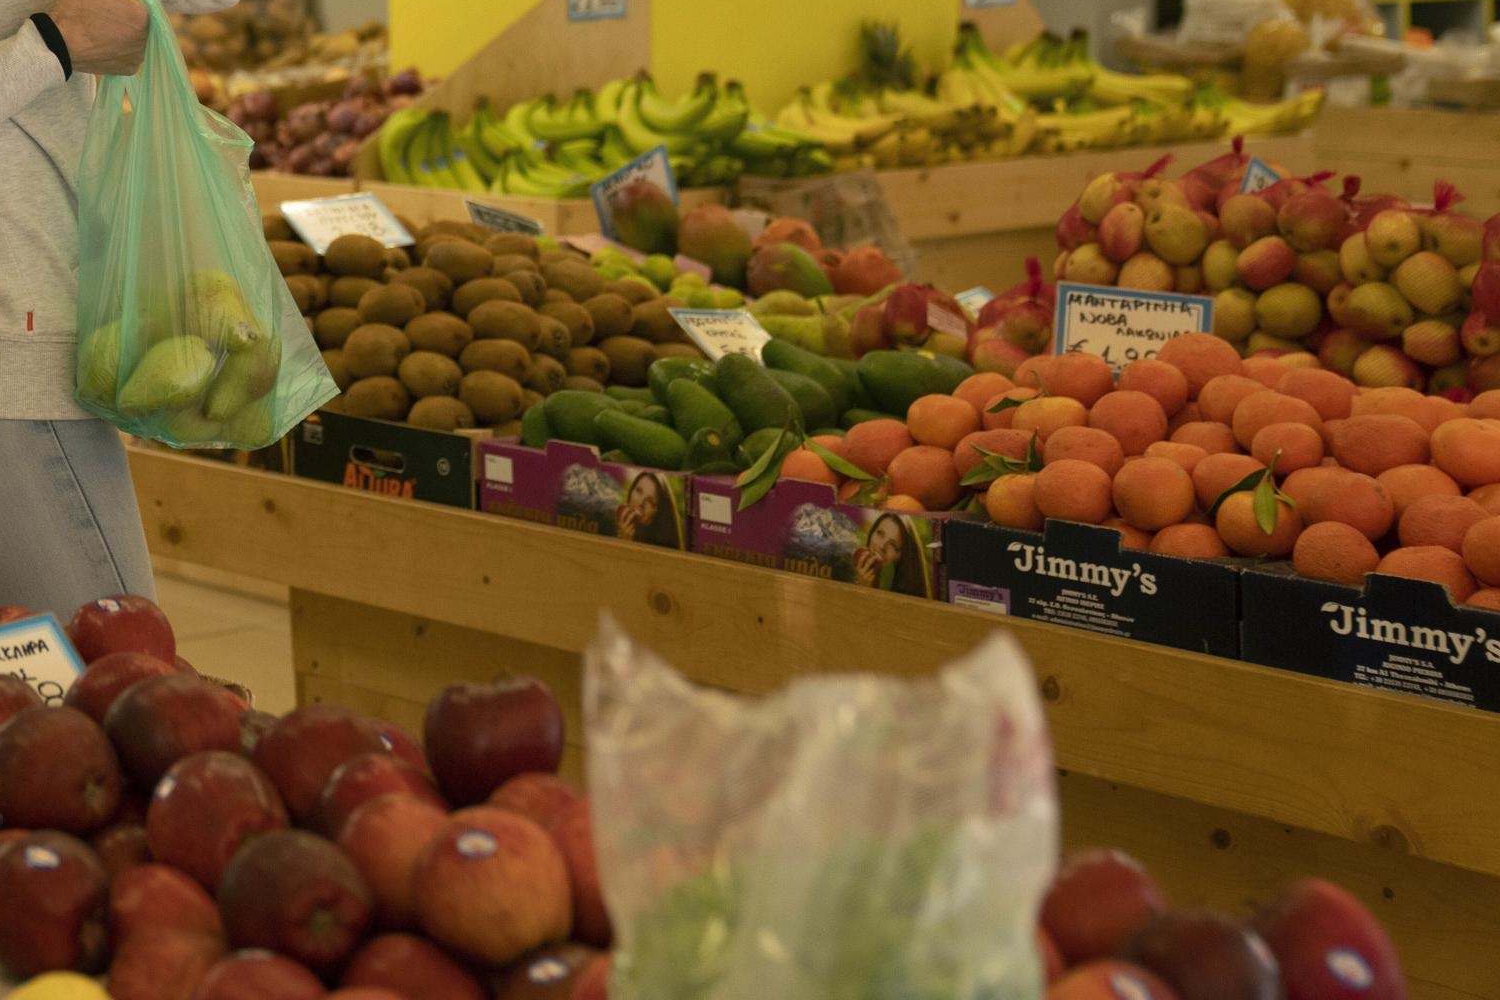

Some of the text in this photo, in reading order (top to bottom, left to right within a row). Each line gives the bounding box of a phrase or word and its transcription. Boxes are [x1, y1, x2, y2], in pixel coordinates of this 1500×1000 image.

[1080, 311, 1128, 326] ΝΟΒΑ
[1008, 542, 1158, 597] Jimmy's
[1320, 602, 1500, 665] Jimmy's
